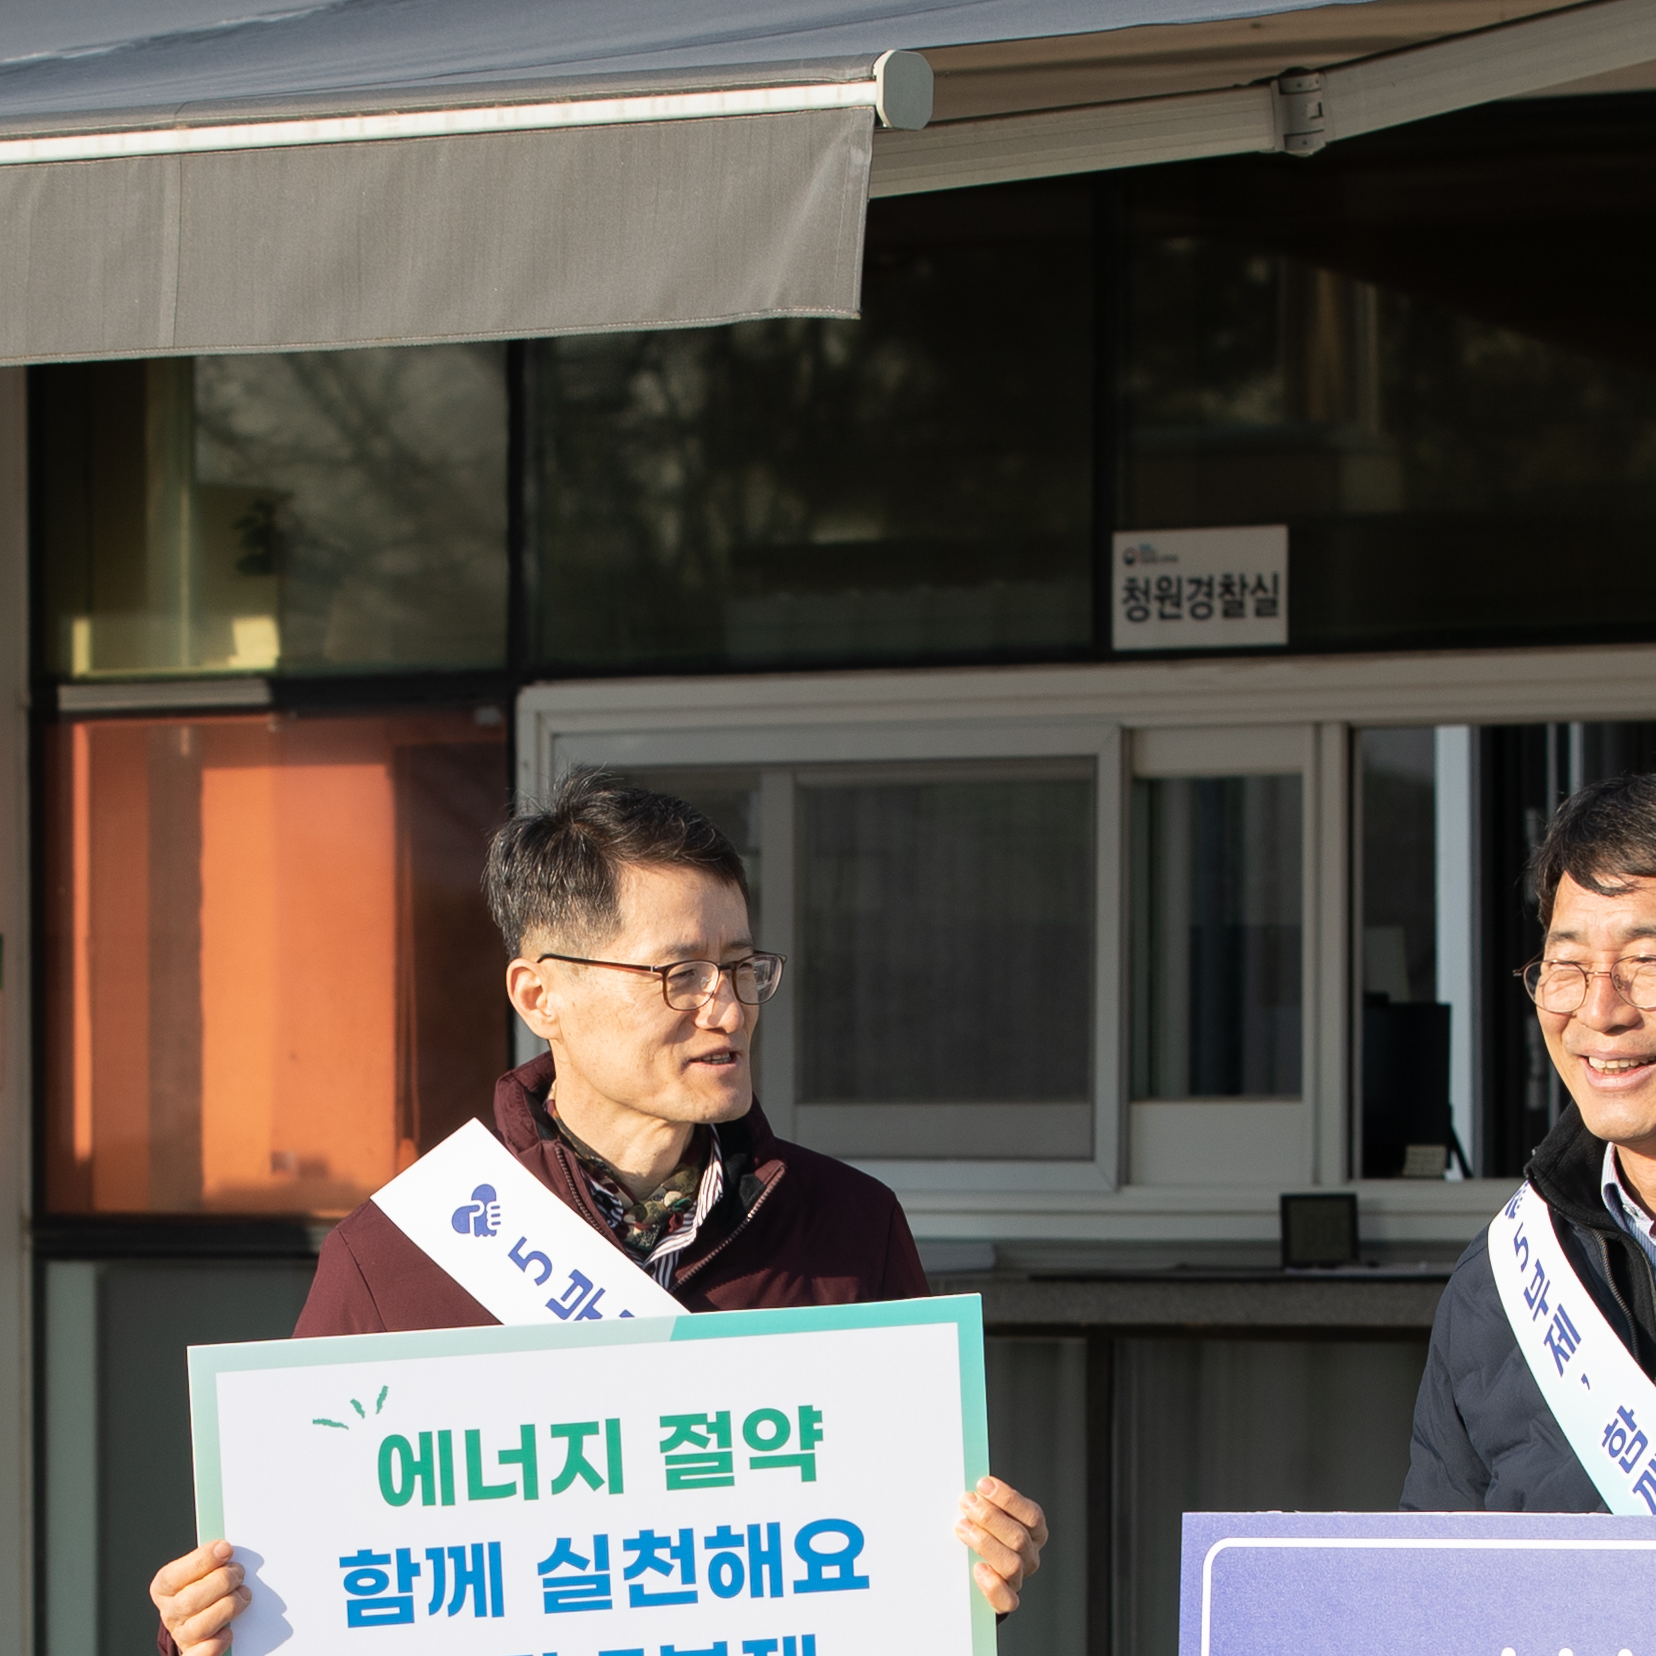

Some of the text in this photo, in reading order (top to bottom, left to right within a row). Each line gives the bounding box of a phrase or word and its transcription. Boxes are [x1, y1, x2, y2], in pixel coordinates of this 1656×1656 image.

[1122, 571, 1280, 623] 청원경찰실
[378, 1405, 823, 1507] 에너지 절약
[339, 1518, 870, 1628] 함께 실천해요
